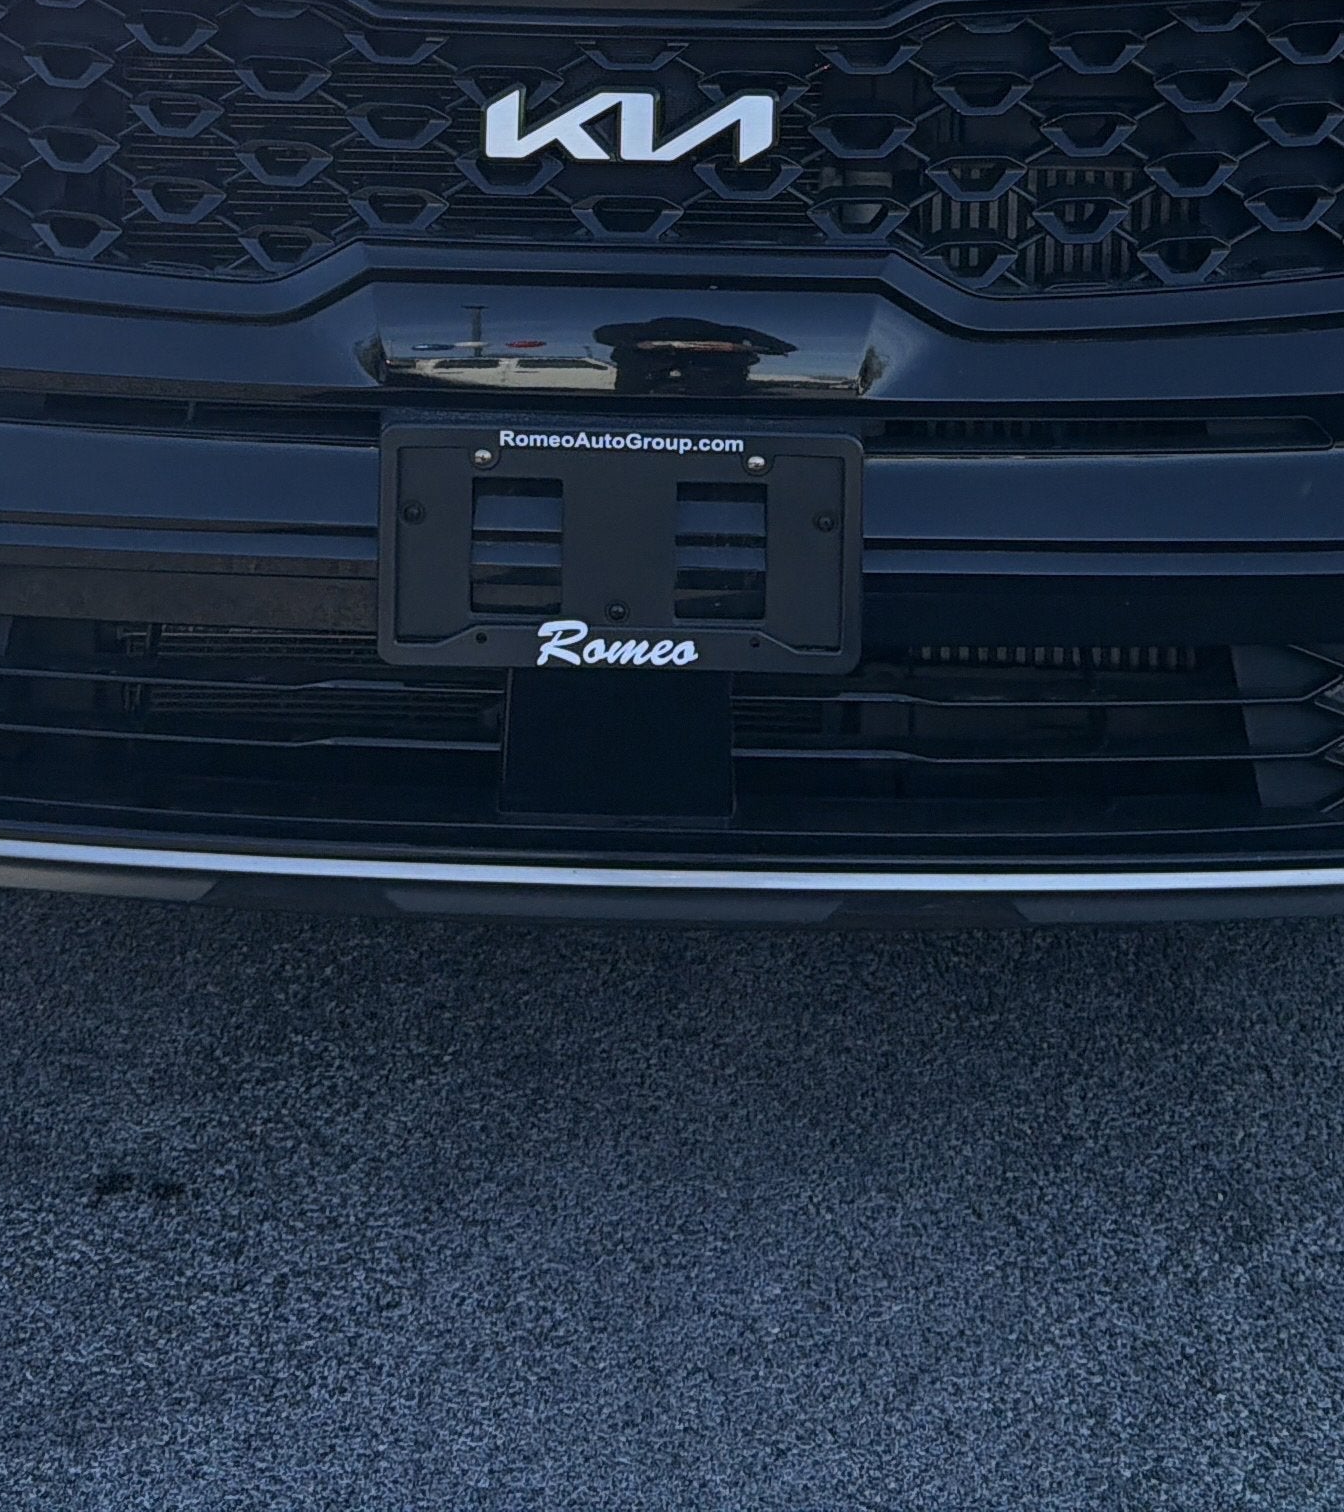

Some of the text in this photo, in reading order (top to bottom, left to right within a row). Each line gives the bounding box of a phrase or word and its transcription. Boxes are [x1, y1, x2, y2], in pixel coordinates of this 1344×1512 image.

[485, 90, 774, 164] KIA
[499, 430, 745, 455] RomeoAutoGroup.com
[537, 620, 699, 666] Romeo
